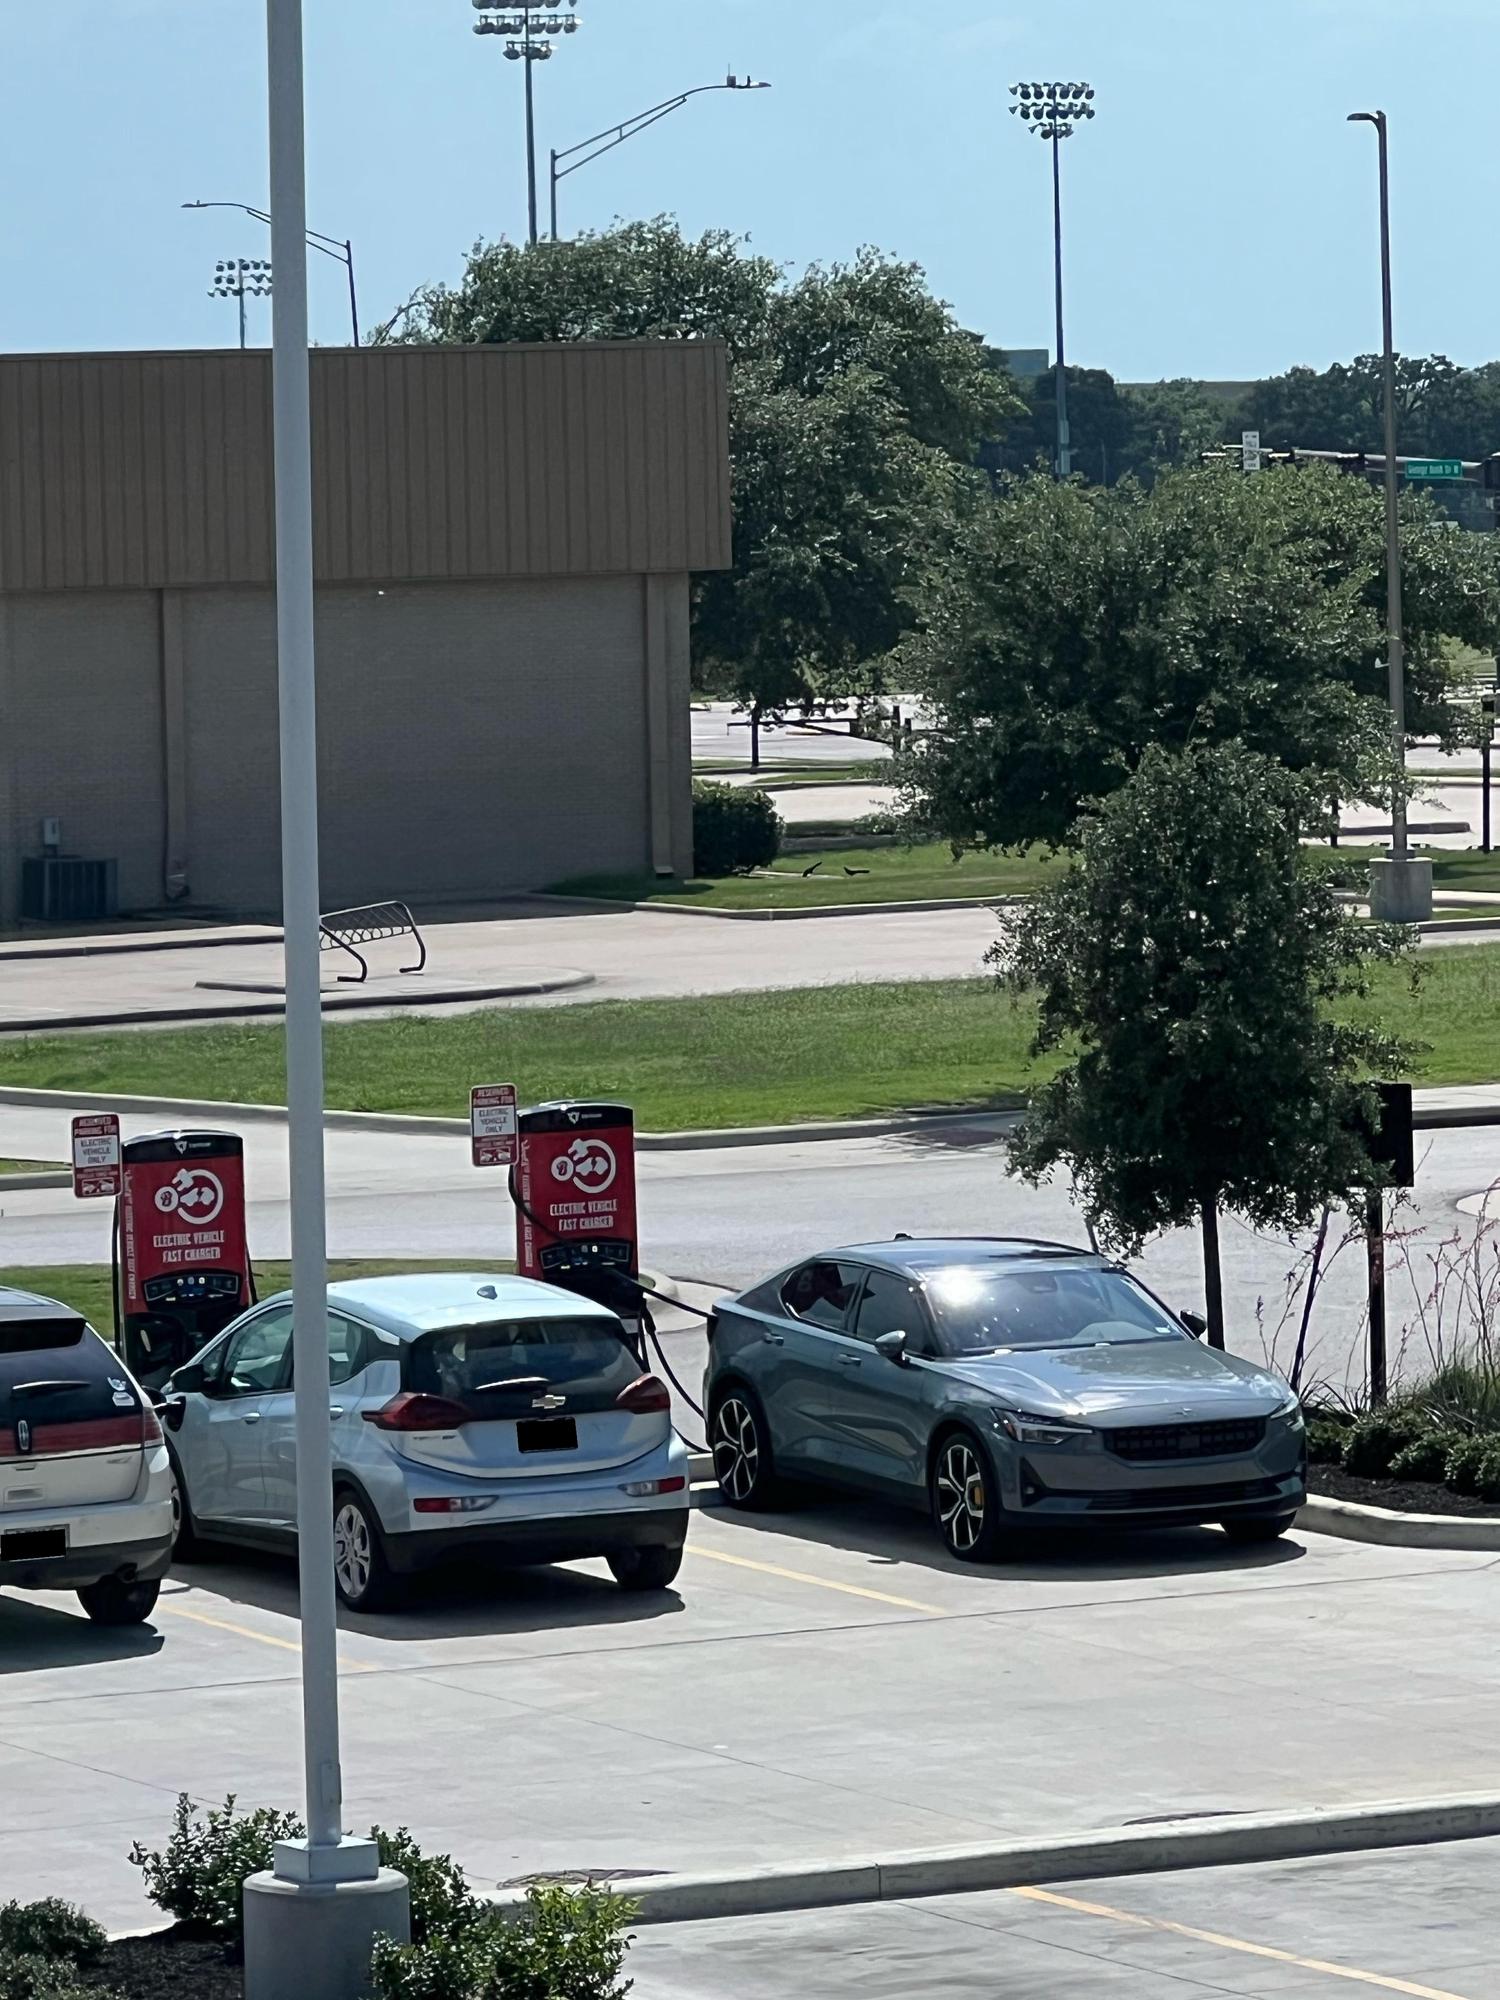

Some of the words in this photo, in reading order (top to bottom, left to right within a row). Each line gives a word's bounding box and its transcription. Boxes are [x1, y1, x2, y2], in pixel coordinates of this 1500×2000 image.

[479, 1108, 509, 1117] ELECTRIC
[481, 1117, 507, 1125] VEHICLE
[485, 1124, 502, 1133] ONLY
[80, 1137, 112, 1147] ELECTRIC
[82, 1147, 111, 1156] VEHICLE
[88, 1156, 106, 1164] ONLY
[550, 1201, 586, 1216] ELECTRIC
[588, 1199, 618, 1213] VEHICLE
[558, 1218, 577, 1231] FAST
[579, 1215, 614, 1230] CHARGER
[153, 1233, 192, 1247] ELECTRIC
[193, 1230, 225, 1244] VEHICLE
[162, 1249, 182, 1263] FAST
[184, 1246, 221, 1261] CHARGER
